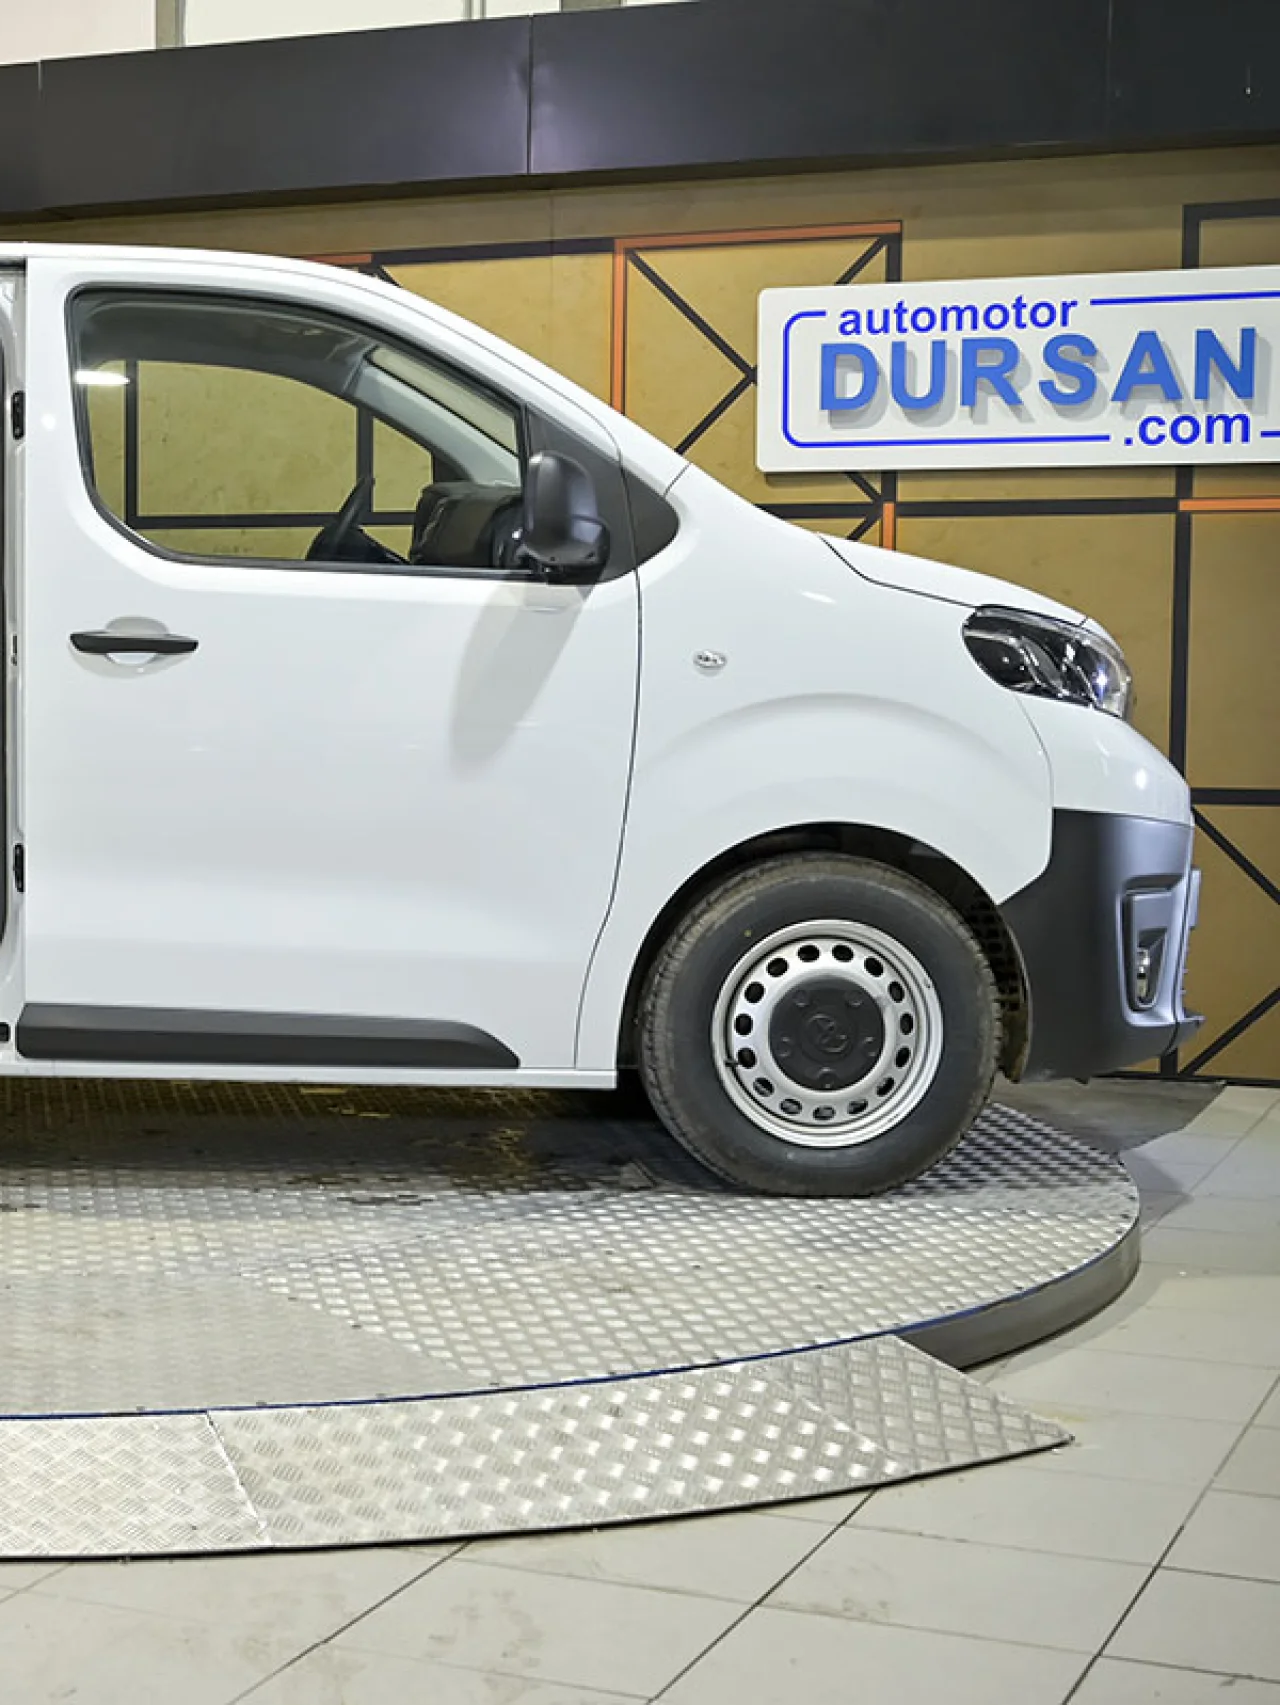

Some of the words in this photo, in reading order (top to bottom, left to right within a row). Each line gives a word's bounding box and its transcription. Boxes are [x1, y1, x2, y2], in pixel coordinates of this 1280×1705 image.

[838, 295, 1078, 336] automotor
[820, 327, 1256, 411] DURSAN
[1124, 413, 1251, 446] .com
